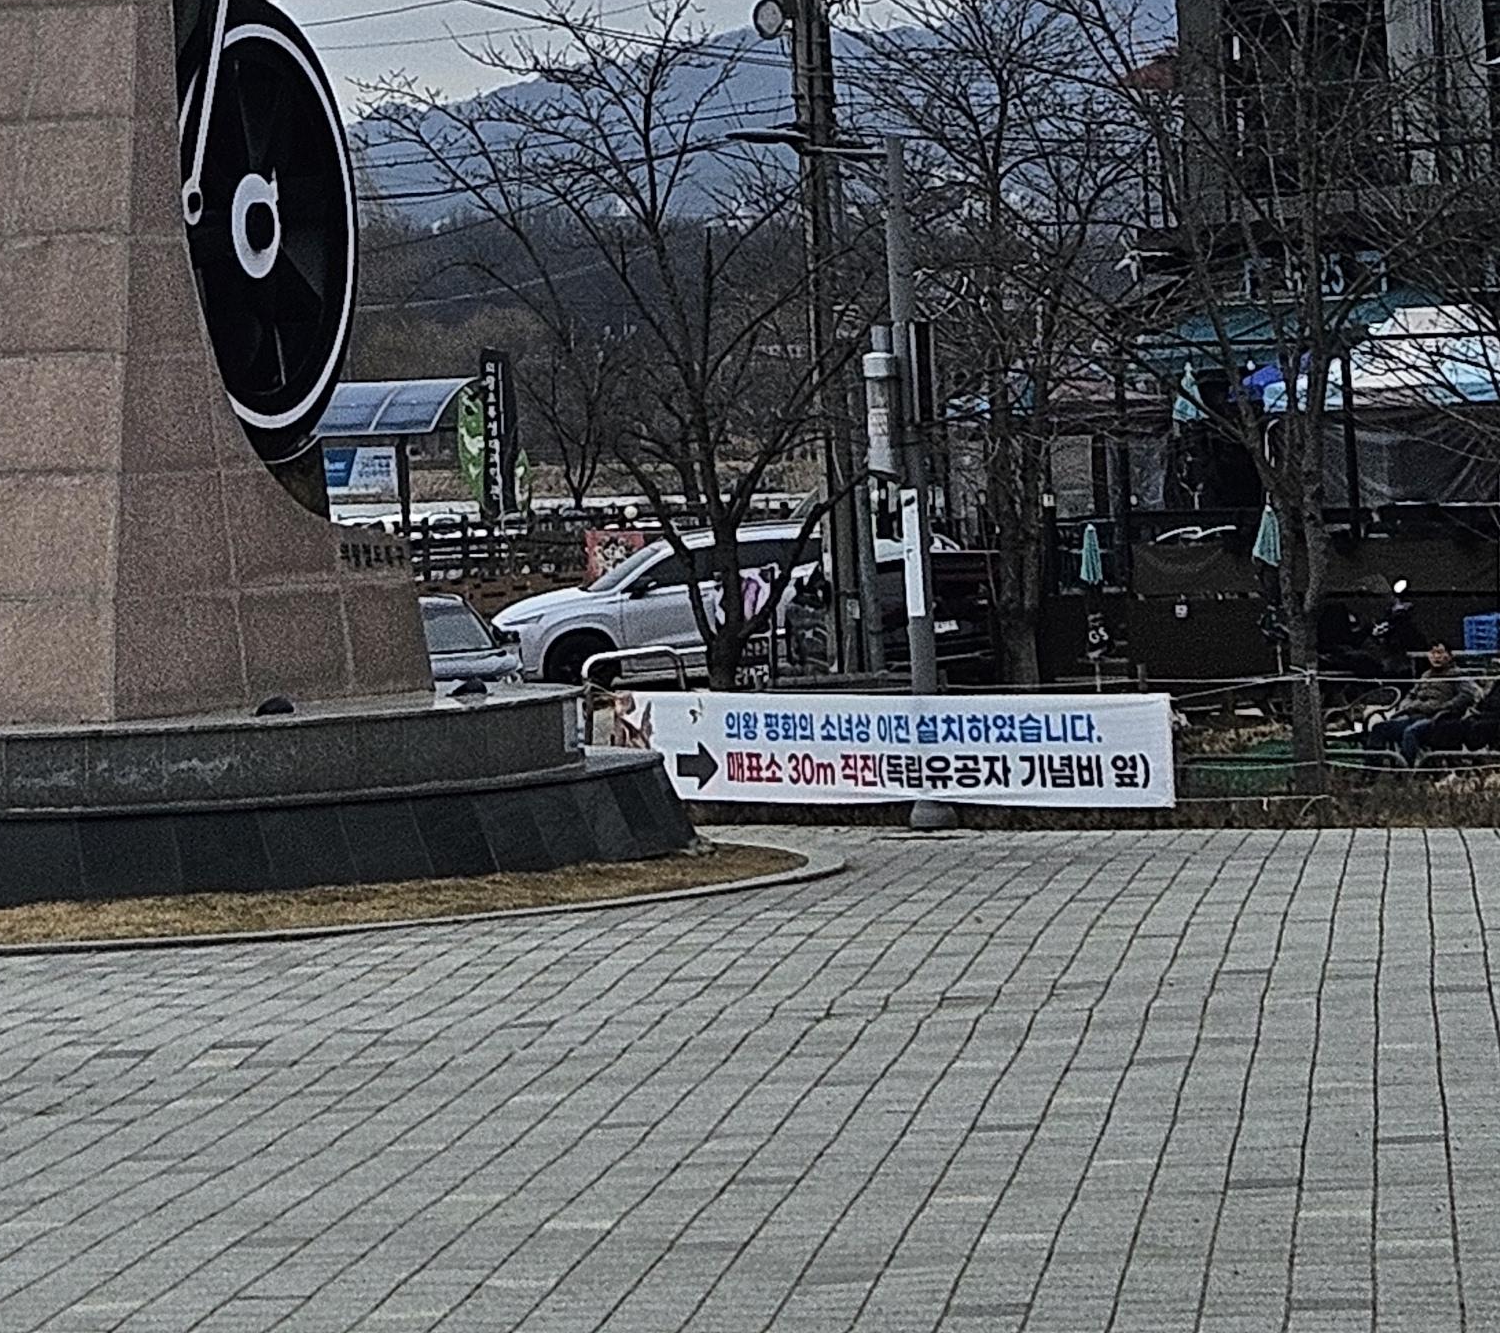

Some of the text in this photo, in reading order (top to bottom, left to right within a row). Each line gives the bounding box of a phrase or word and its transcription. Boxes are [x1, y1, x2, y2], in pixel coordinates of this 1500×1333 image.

[725, 711, 1103, 745] 의왕 평화의 소녀상 이전 설치하였습니다.
[726, 751, 784, 783] 매표소
[787, 752, 836, 786] 30m
[1018, 753, 1104, 789] 기념비
[1110, 753, 1151, 790] 옆)
